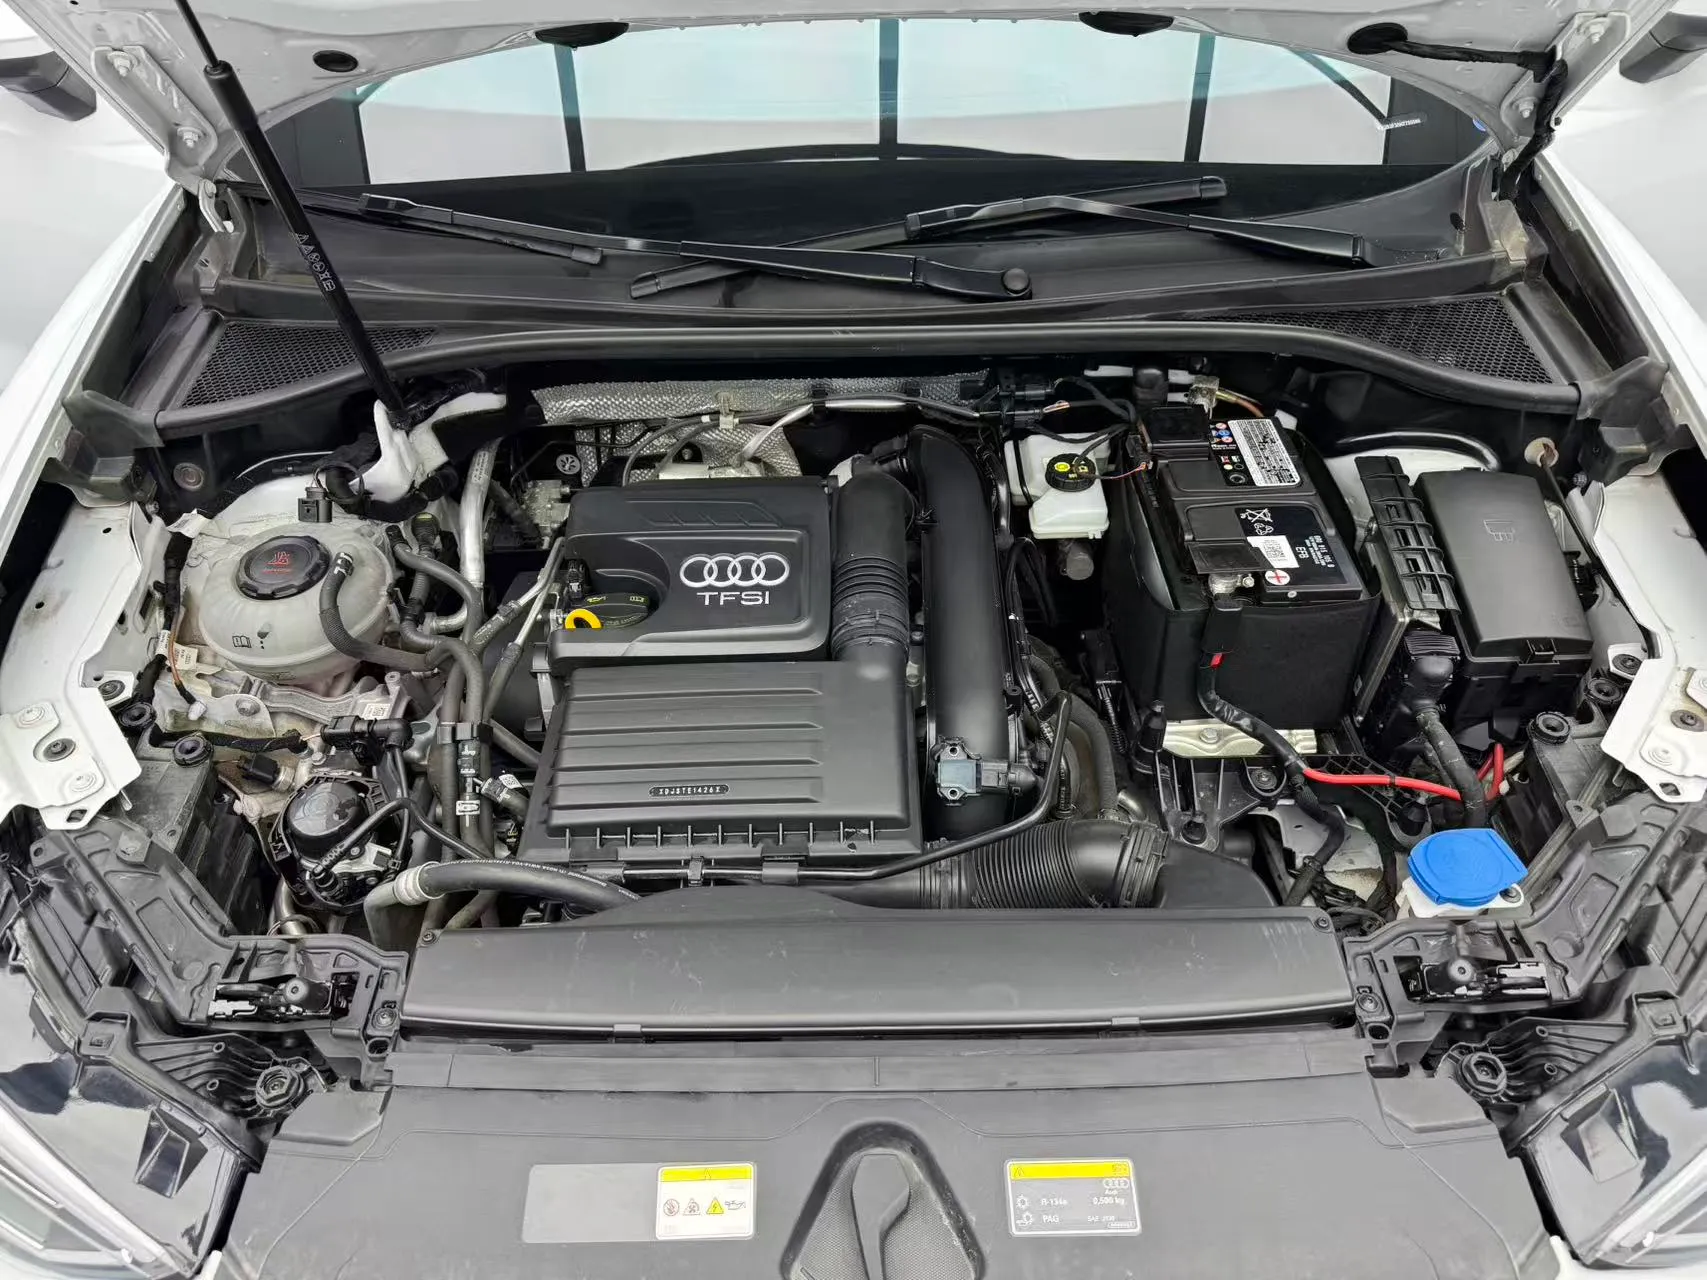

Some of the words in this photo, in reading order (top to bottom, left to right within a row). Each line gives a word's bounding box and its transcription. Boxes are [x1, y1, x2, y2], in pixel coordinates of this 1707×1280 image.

[1296, 547, 1309, 558] EFB
[697, 591, 770, 605] TFSI
[1043, 1215, 1059, 1223] PAG
